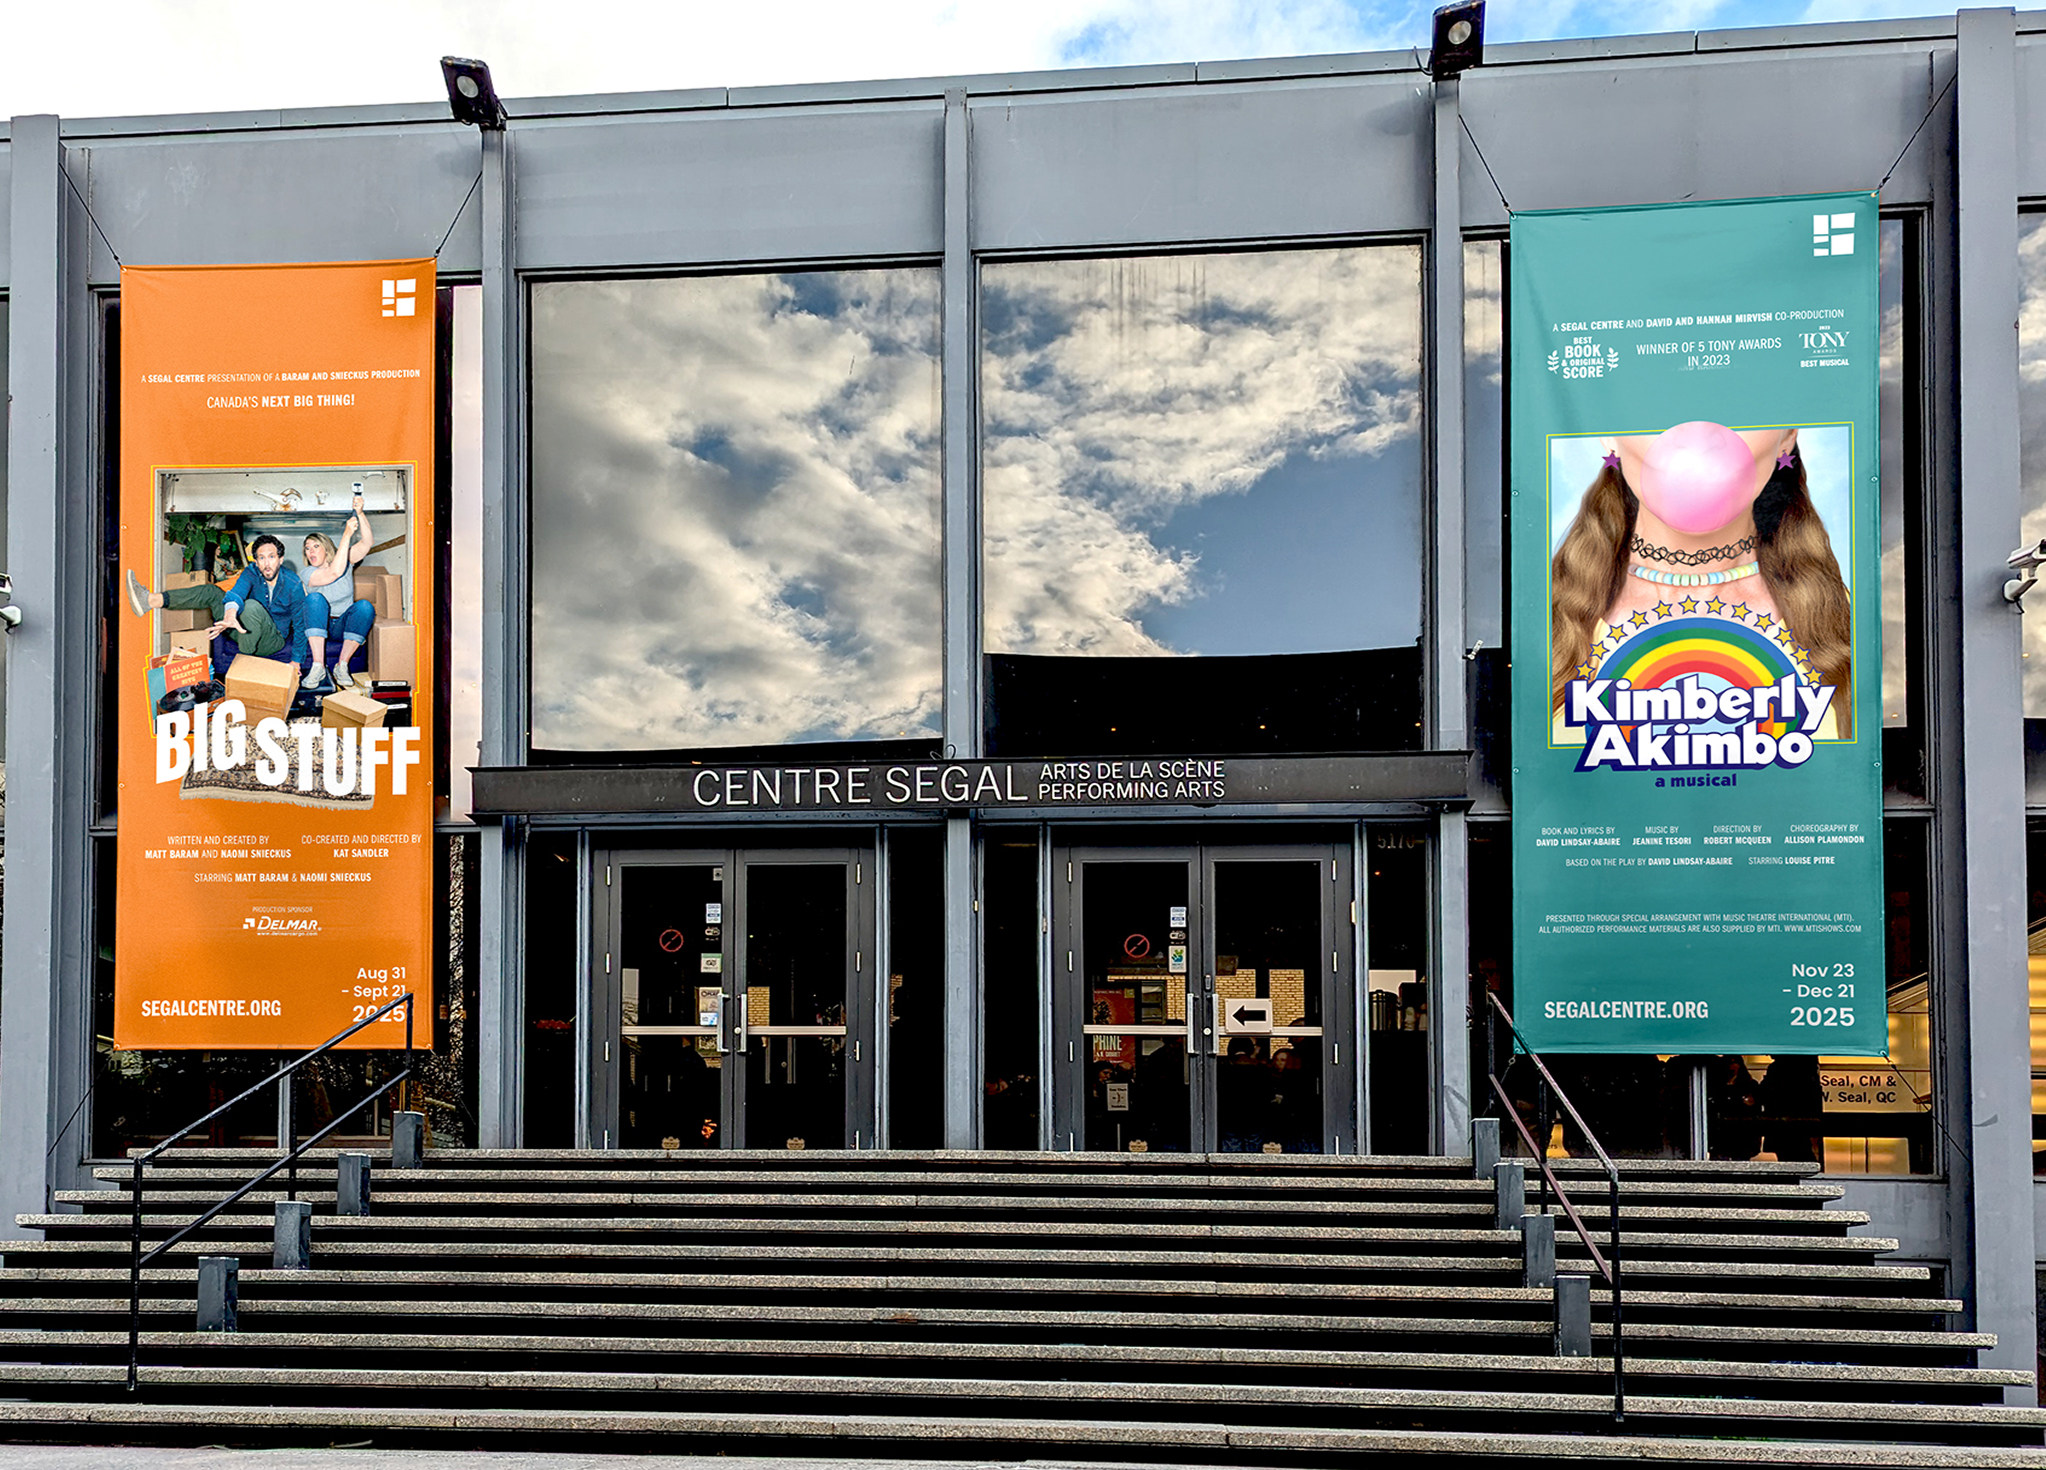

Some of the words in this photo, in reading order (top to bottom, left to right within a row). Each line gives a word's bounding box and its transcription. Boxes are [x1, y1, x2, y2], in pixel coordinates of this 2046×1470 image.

[1561, 322, 1588, 331] SEGAL
[1591, 320, 1623, 330] CENTRE
[1626, 319, 1643, 328] AND
[1647, 318, 1672, 327] DAVID
[1675, 317, 1693, 326] AND
[1697, 315, 1732, 324] HANNAH
[1736, 313, 1772, 323] MIRVISH
[1775, 309, 1844, 321] CO-PRODUCTION
[1574, 336, 1592, 344] BEST
[1637, 343, 1678, 354] WINNER
[1682, 342, 1695, 353] OF
[1699, 341, 1705, 352] 5
[1708, 340, 1735, 351] TONY
[1739, 338, 1781, 350] AWARDS
[1799, 331, 1850, 348] TONY
[1565, 344, 1601, 358] BOOK
[1570, 358, 1605, 366] ORIGINAL
[1688, 356, 1699, 366] IN
[1702, 354, 1730, 366] 2023
[148, 375, 172, 383] SEGAL
[175, 374, 205, 382] CENTRE
[207, 373, 261, 382] PRESENTATION
[263, 373, 273, 381] OF
[275, 373, 280, 381] A
[282, 373, 309, 381] BARAM
[312, 372, 328, 380] AND
[330, 371, 369, 380] SNIECKUS
[371, 370, 420, 378] PRODUCTION
[1563, 366, 1604, 379] SCORE
[207, 396, 258, 408] CANADA'S
[262, 396, 290, 407] NEXT
[294, 395, 313, 406] BIG
[317, 394, 354, 406] THING!
[1565, 672, 1837, 730] Kimberly
[156, 699, 246, 784] BIG
[256, 716, 420, 796] STUFF
[1574, 720, 1814, 772] Akimbo
[1041, 763, 1090, 779] ARTS
[1098, 763, 1123, 779] DE
[1130, 762, 1153, 778] LA
[1159, 759, 1224, 778] SCÈNE
[692, 767, 871, 807] CENTRE
[884, 765, 1029, 803] SEGAL
[1655, 776, 1665, 787] a
[1671, 774, 1737, 787] musical
[1039, 782, 1168, 799] PERFORMING
[1175, 781, 1224, 797] ARTS
[1645, 826, 1668, 834] MUSIC
[1713, 825, 1750, 833] DIRECTION
[1790, 824, 1847, 832] CHOREOGRAPHY
[1850, 824, 1858, 832] BY
[168, 836, 201, 844] WRITTEN
[204, 836, 220, 844] AND
[223, 835, 257, 844] CREATED
[259, 835, 269, 844] BY
[302, 835, 349, 844] CO-CREATED
[352, 835, 368, 843] AND
[371, 834, 409, 843] DIRECTED
[412, 834, 421, 843] BY
[1735, 836, 1771, 845] MCQUEEN
[145, 850, 167, 858] MATT
[170, 850, 198, 858] BARAM
[201, 850, 218, 858] AND
[221, 849, 248, 858] NAOMI
[251, 849, 291, 858] SNIECKUS
[334, 849, 349, 857] KAT
[352, 848, 389, 857] SANDLER
[1591, 858, 1601, 866] ON
[1603, 858, 1616, 866] THE
[1619, 858, 1635, 866] PLAY
[1637, 858, 1646, 866] BY
[1749, 857, 1783, 865] STARRING
[194, 873, 232, 882] STARRING
[235, 873, 256, 882] MATT
[260, 873, 288, 882] BARAM
[292, 873, 297, 882] &
[300, 873, 327, 882] NAOMI
[330, 873, 371, 882] SNIECKUS
[1587, 914, 1619, 922] THROUGH
[1622, 914, 1649, 922] SPECIAL
[1778, 913, 1831, 921] INTERNATIONAL
[1834, 914, 1854, 922] (MTI).
[1552, 925, 1595, 933] AUTHORIZED
[1597, 925, 1647, 933] PERFORMANCE
[357, 968, 387, 983] Aug
[392, 967, 405, 979] 31
[1793, 964, 1828, 977] Nov
[1833, 964, 1854, 977] 23
[354, 986, 388, 1000] Sept
[391, 986, 405, 997] 21
[1798, 985, 1832, 997] Dec
[1838, 984, 1854, 997] 21
[142, 1000, 281, 1016] SEGALCENTRE.ORG
[1545, 1001, 1708, 1018] SEGALCENTRE.ORG
[1791, 1007, 1854, 1026] 2025
[1821, 1075, 1854, 1088] Seal,
[1860, 1076, 1880, 1086] CM
[1886, 1076, 1896, 1086] &
[1838, 1092, 1871, 1104] Seal,
[1877, 1092, 1896, 1104] QC
